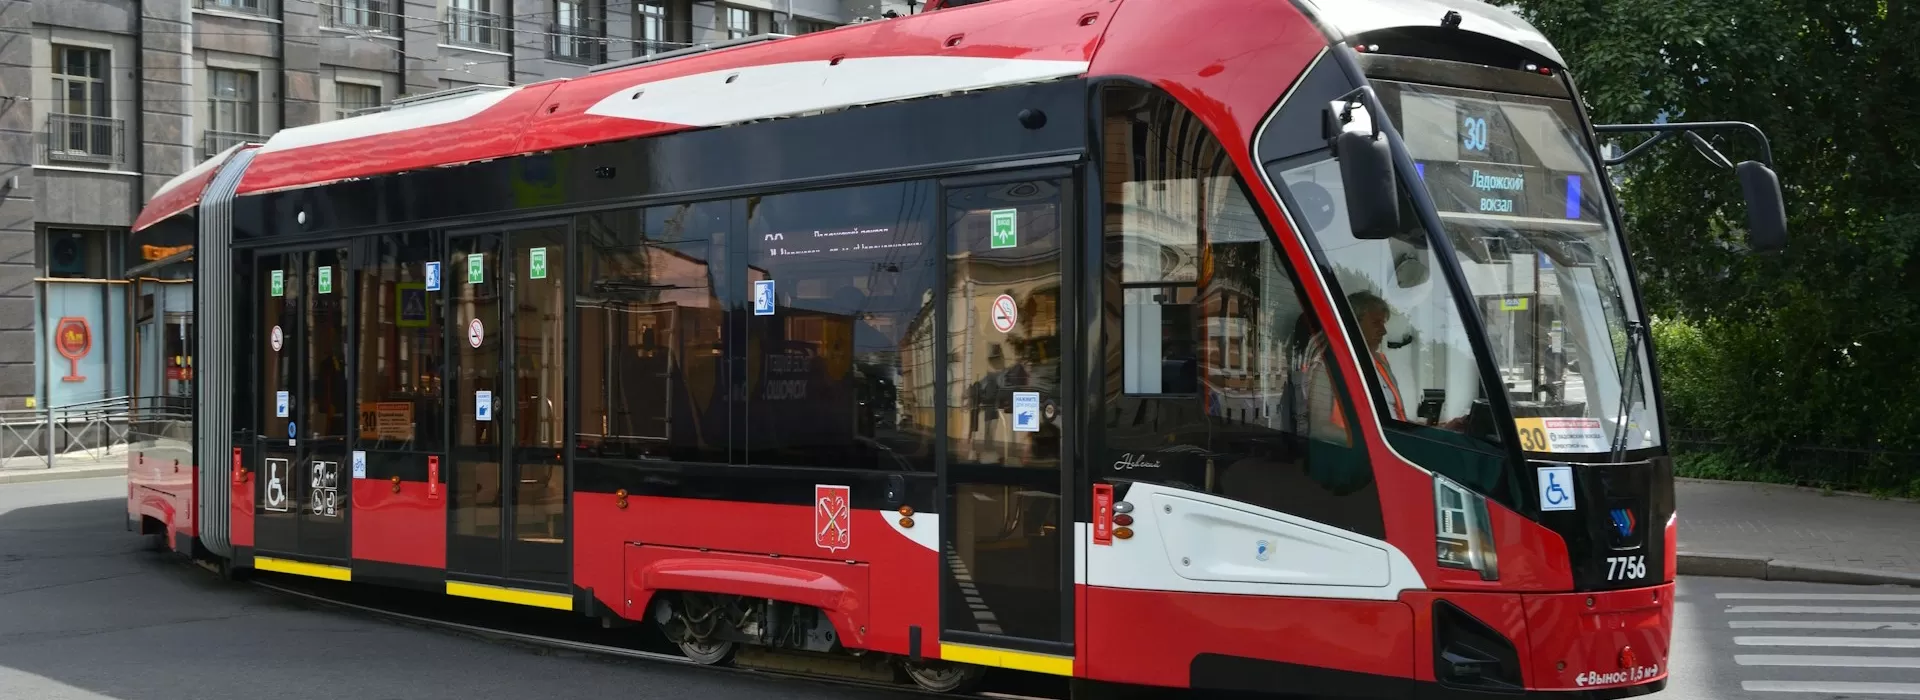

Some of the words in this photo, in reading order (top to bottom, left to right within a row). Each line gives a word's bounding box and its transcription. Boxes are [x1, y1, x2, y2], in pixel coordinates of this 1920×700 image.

[1463, 116, 1488, 151] 30
[1470, 169, 1524, 191] Ладожский
[1480, 197, 1513, 212] вокзал
[1520, 427, 1546, 450] 30
[1607, 555, 1646, 581] 7756
[1588, 671, 1627, 685] Вынос
[1630, 664, 1644, 682] 1,5
